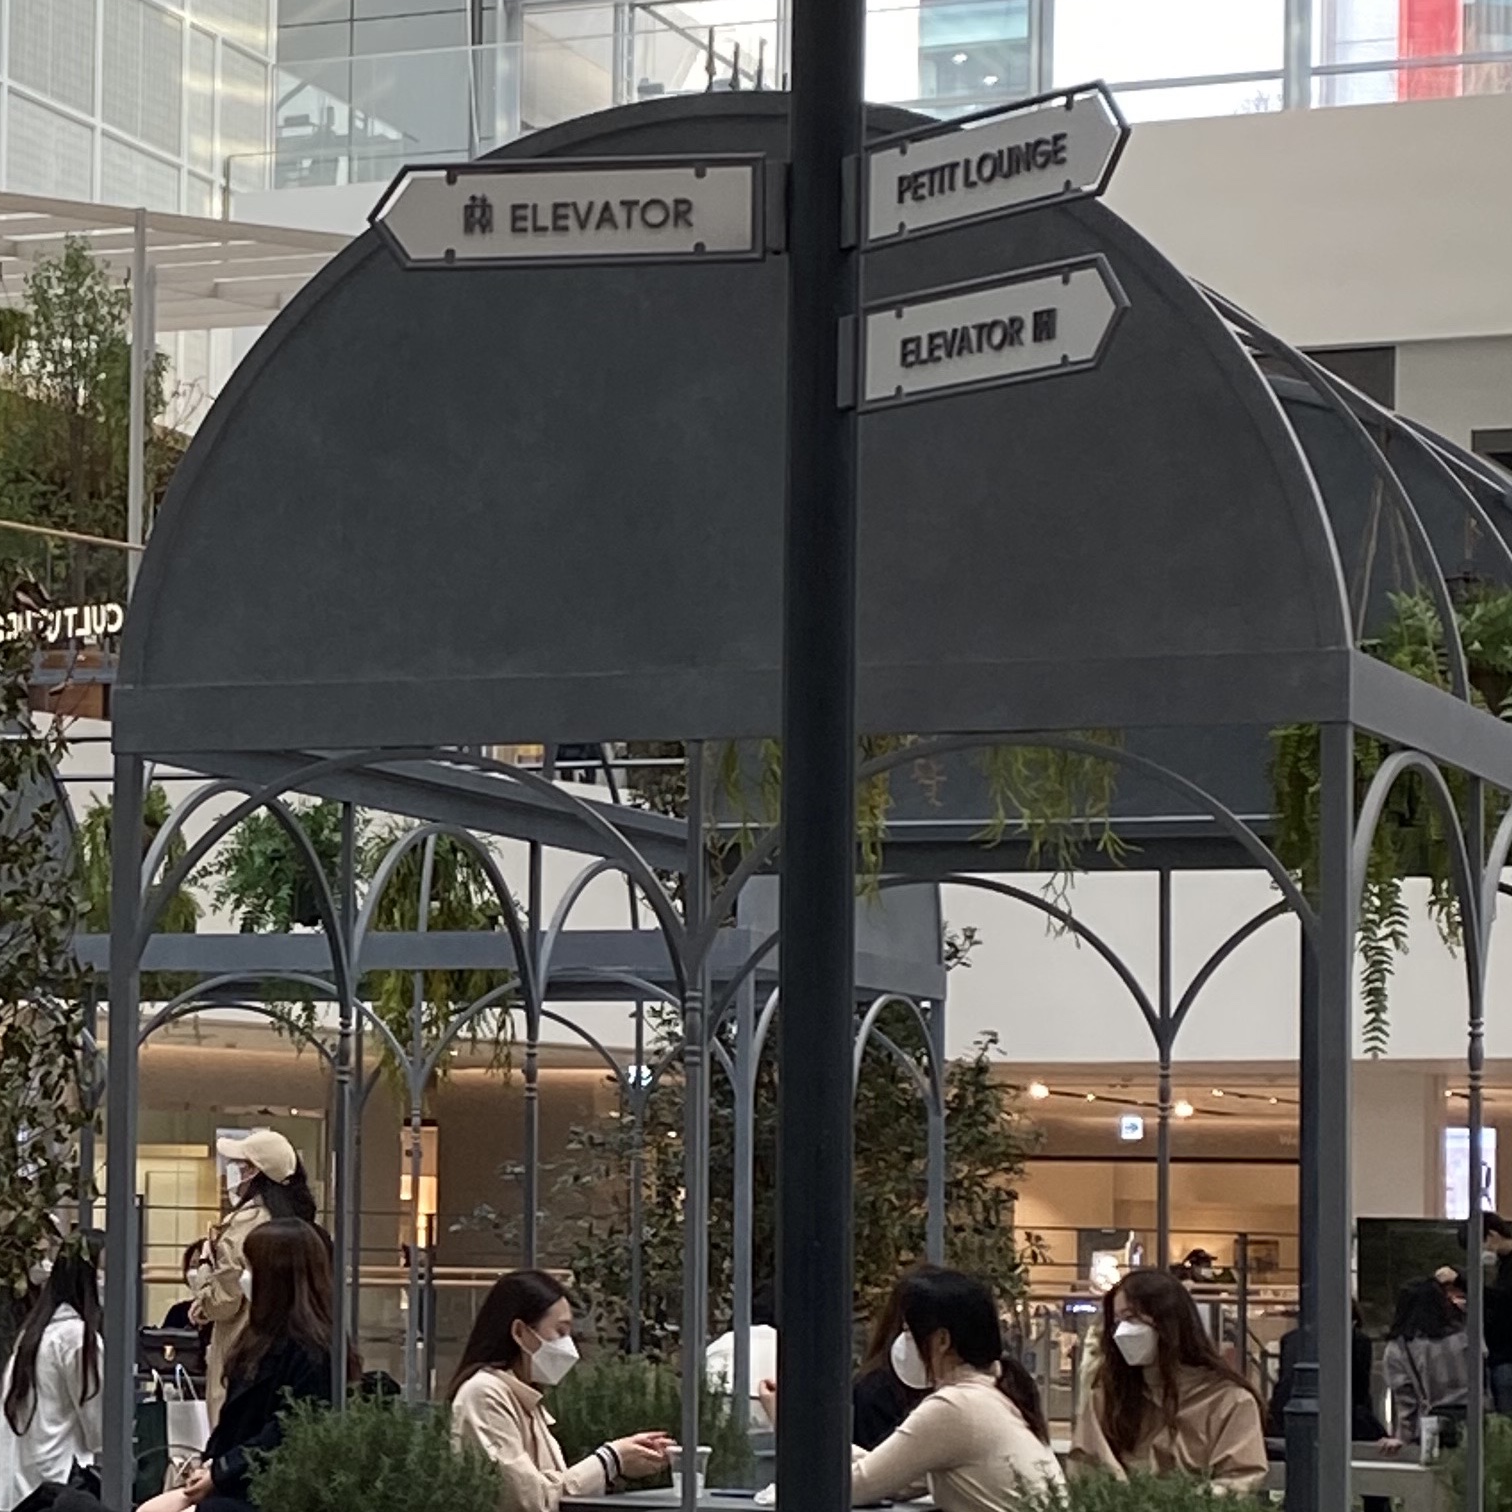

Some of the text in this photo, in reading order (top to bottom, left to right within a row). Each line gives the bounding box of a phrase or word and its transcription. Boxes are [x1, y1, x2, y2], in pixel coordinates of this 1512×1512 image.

[896, 132, 1069, 204] PETIT LOUNGE
[510, 197, 695, 235] ELEVATOR
[899, 314, 1026, 370] ELEVATOR
